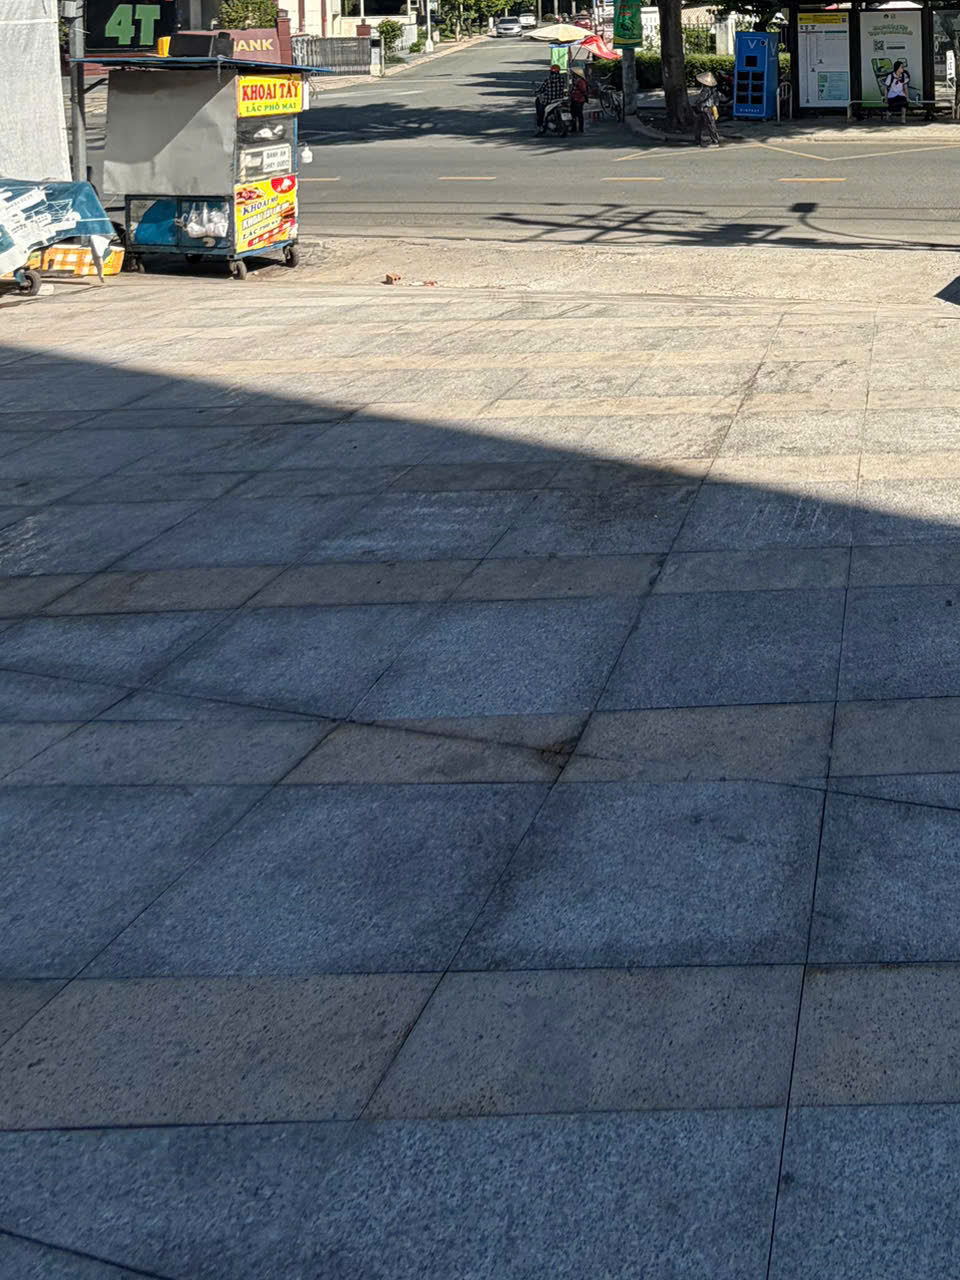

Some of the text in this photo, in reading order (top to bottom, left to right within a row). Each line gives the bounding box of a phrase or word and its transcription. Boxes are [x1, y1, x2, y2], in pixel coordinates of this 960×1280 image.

[105, 4, 161, 45] 4T
[234, 38, 274, 53] ANK
[241, 80, 300, 102] KHOAI TÂY
[282, 102, 297, 110] MAI
